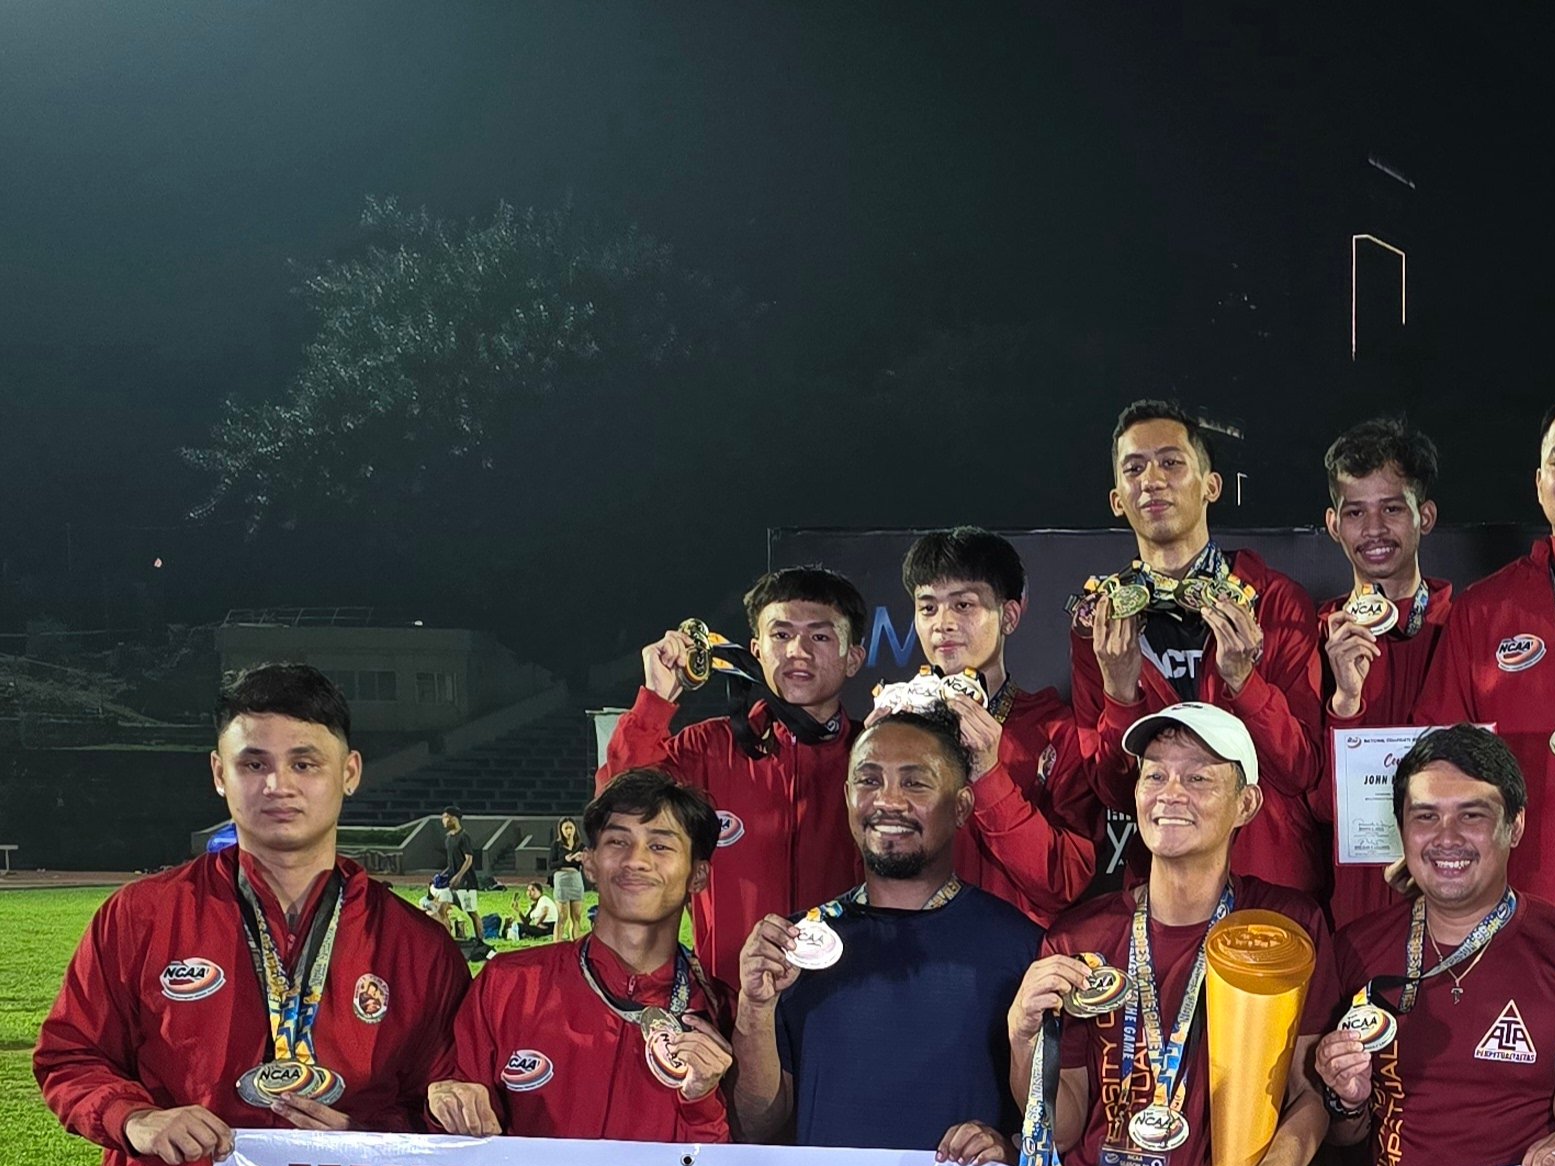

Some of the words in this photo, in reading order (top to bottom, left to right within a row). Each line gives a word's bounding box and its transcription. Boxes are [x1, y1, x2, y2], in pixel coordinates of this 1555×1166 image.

[1351, 603, 1383, 615] NCAA
[1499, 641, 1532, 654] NCAA
[944, 678, 976, 699] NCAA
[1363, 775, 1388, 785] JOHN
[163, 966, 207, 979] NCAA
[1341, 1015, 1377, 1031] NCAA
[1123, 1026, 1137, 1060] GAME
[508, 1057, 536, 1071] CAA
[260, 1068, 301, 1081] NCAA
